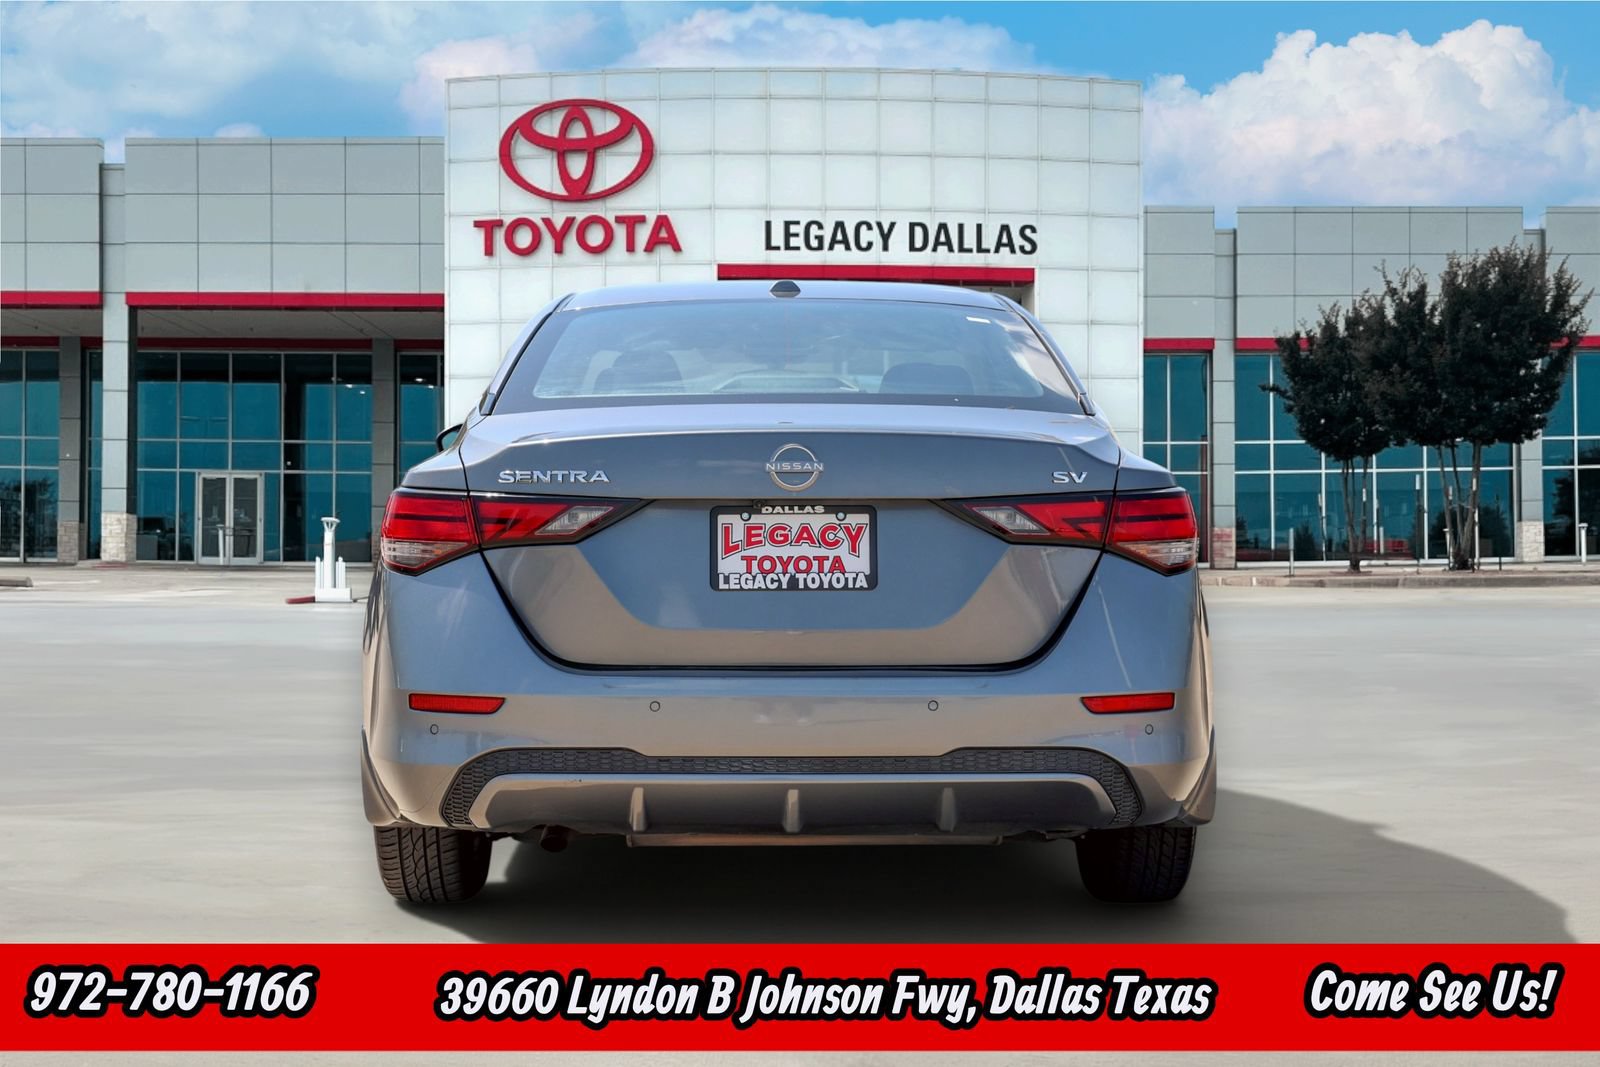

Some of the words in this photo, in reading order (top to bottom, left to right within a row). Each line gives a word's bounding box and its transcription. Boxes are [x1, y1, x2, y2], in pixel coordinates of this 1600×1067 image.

[473, 214, 683, 257] TOYOTA
[765, 220, 896, 252] LEGACY
[908, 222, 1038, 255] DALLAS
[765, 462, 824, 472] NISSAN
[498, 470, 610, 483] SENTRA
[1052, 471, 1088, 484] SV
[761, 506, 825, 514] DALLAS
[722, 523, 868, 560] LEGACY
[741, 555, 846, 574] TOYOTA
[718, 573, 791, 590] LEGACY
[796, 572, 868, 590] TOYOTA
